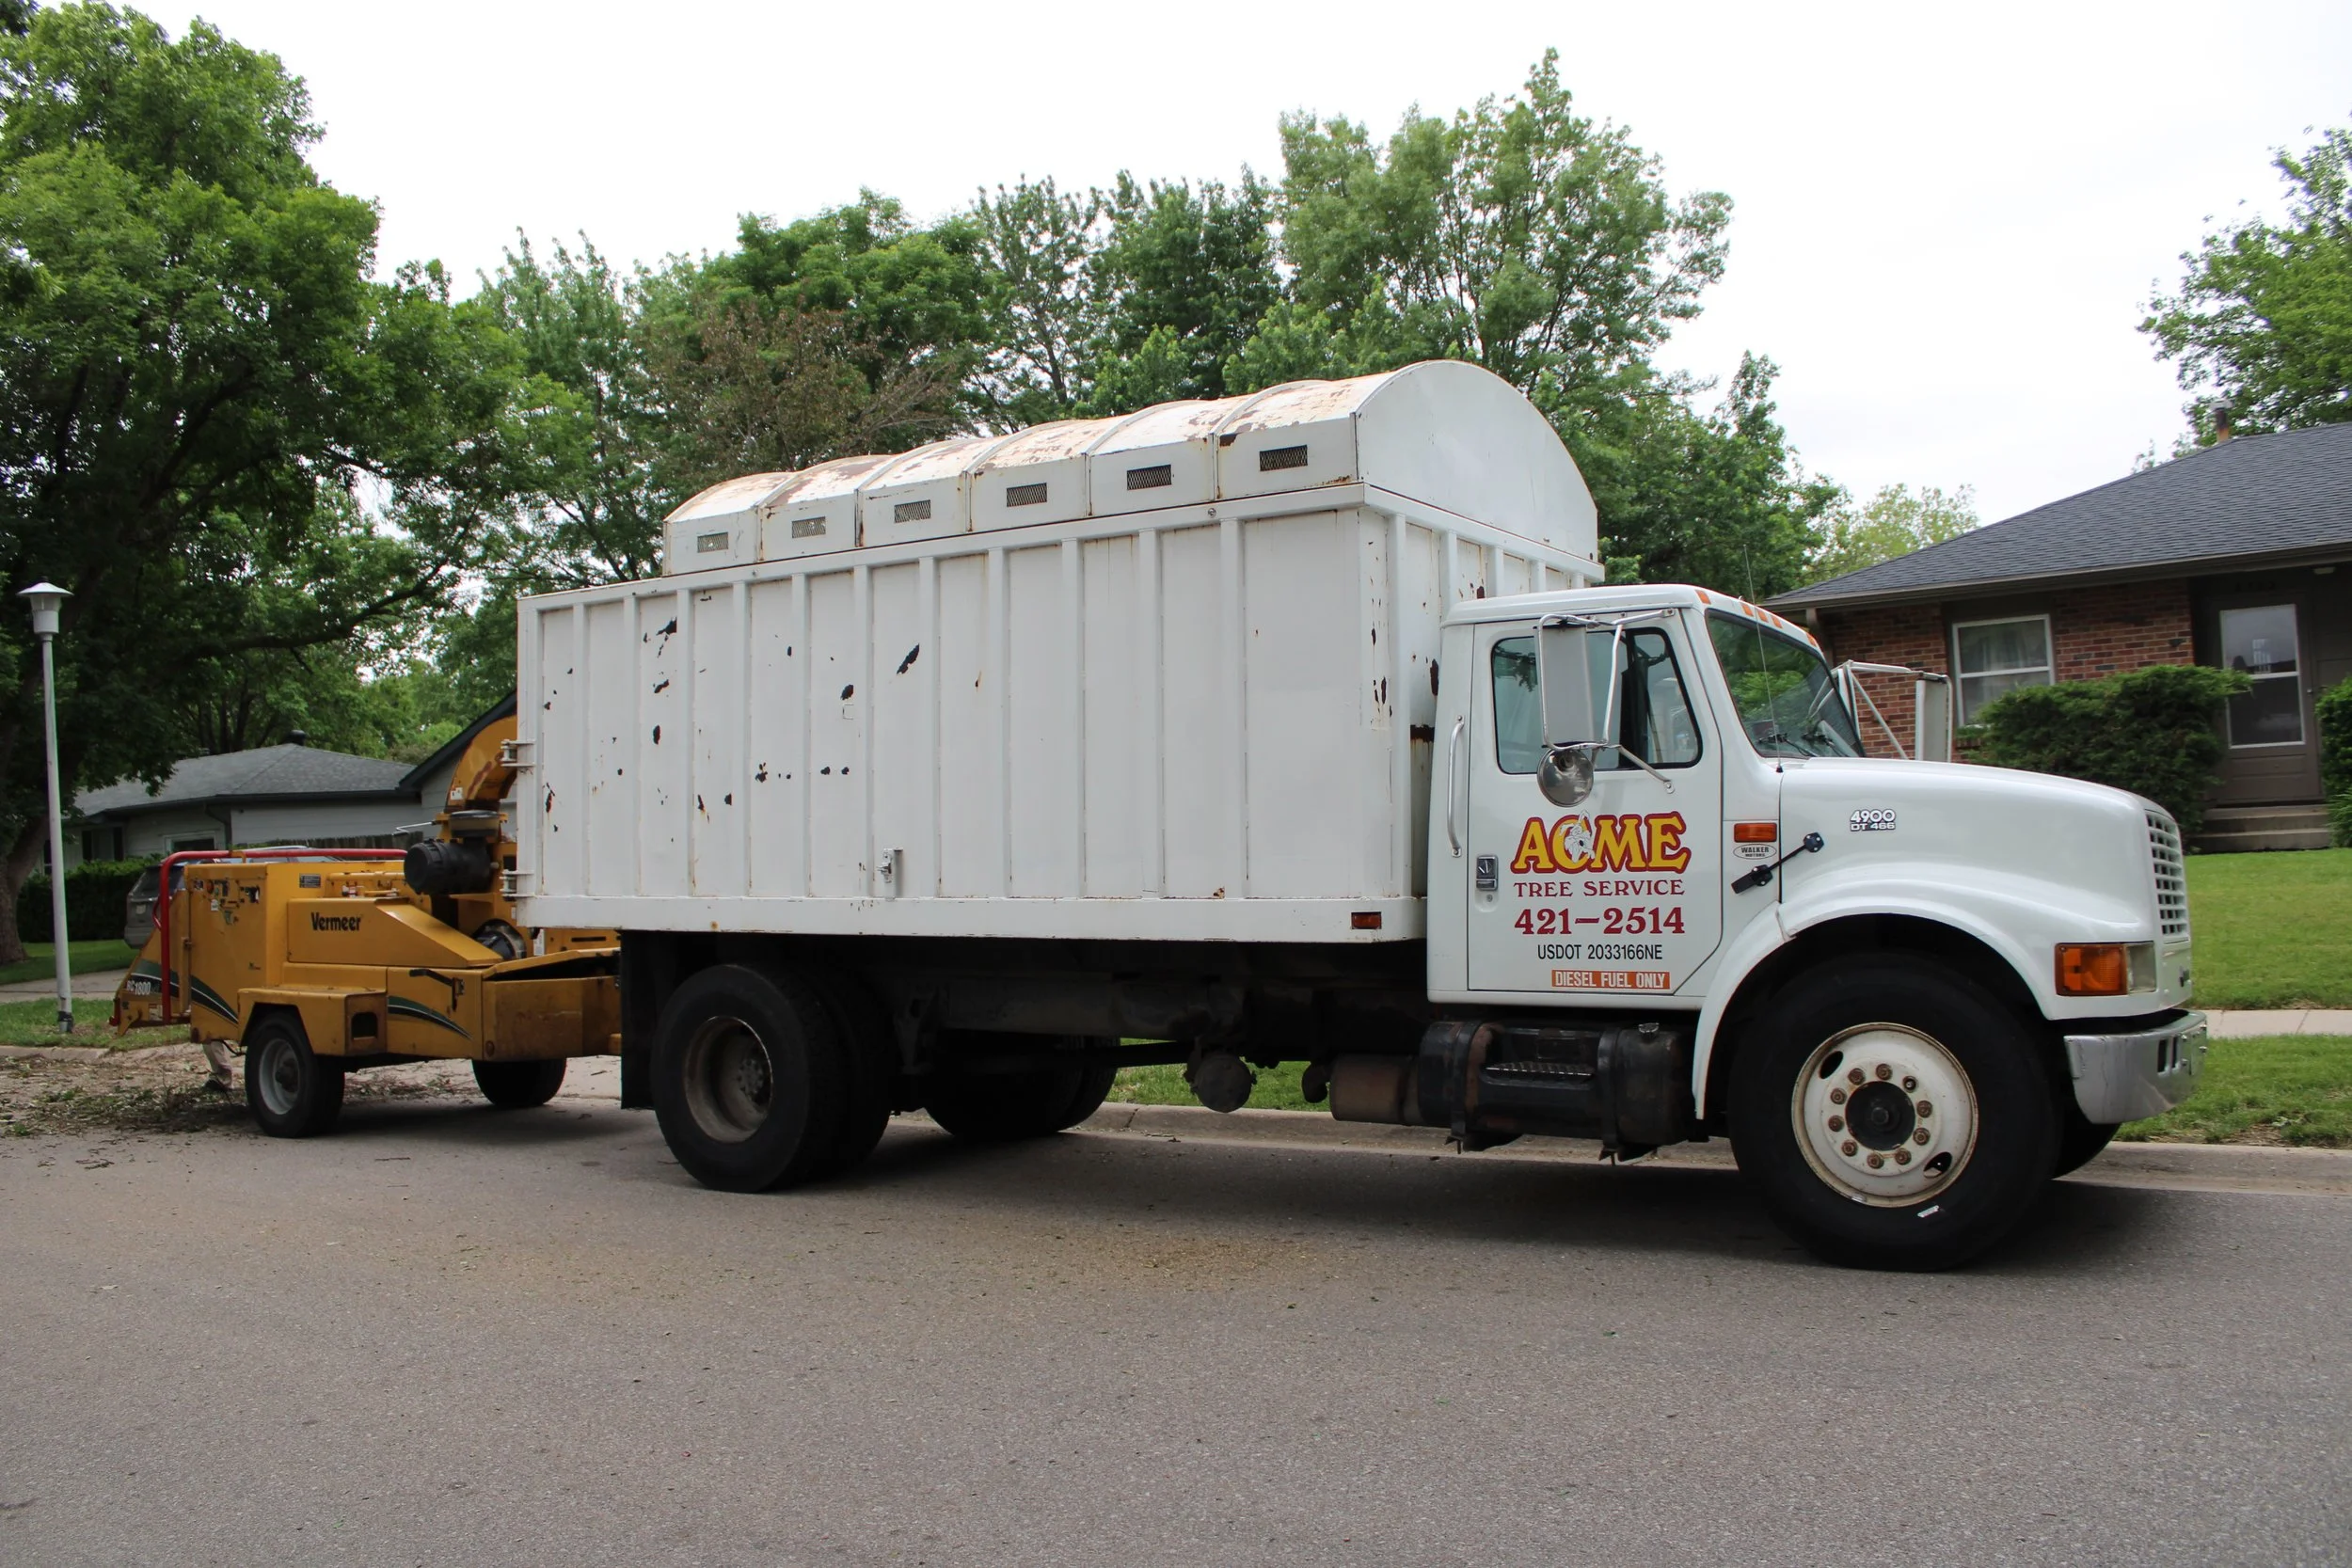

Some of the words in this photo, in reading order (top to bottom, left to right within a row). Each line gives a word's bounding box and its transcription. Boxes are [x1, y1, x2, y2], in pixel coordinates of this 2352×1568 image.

[1851, 809, 1896, 823] 4900
[1510, 811, 1692, 874] ACME
[1513, 880, 1574, 897] TREE
[1583, 879, 1685, 896] SERVICE
[310, 911, 361, 931] Vermeer
[1514, 907, 1685, 934] 421-2514
[1537, 944, 1582, 959] USDOT
[1587, 944, 1663, 959] 2033166NE
[1555, 971, 1597, 987] DIESEL
[1600, 972, 1632, 988] FUEL
[1636, 972, 1665, 988] ONLY
